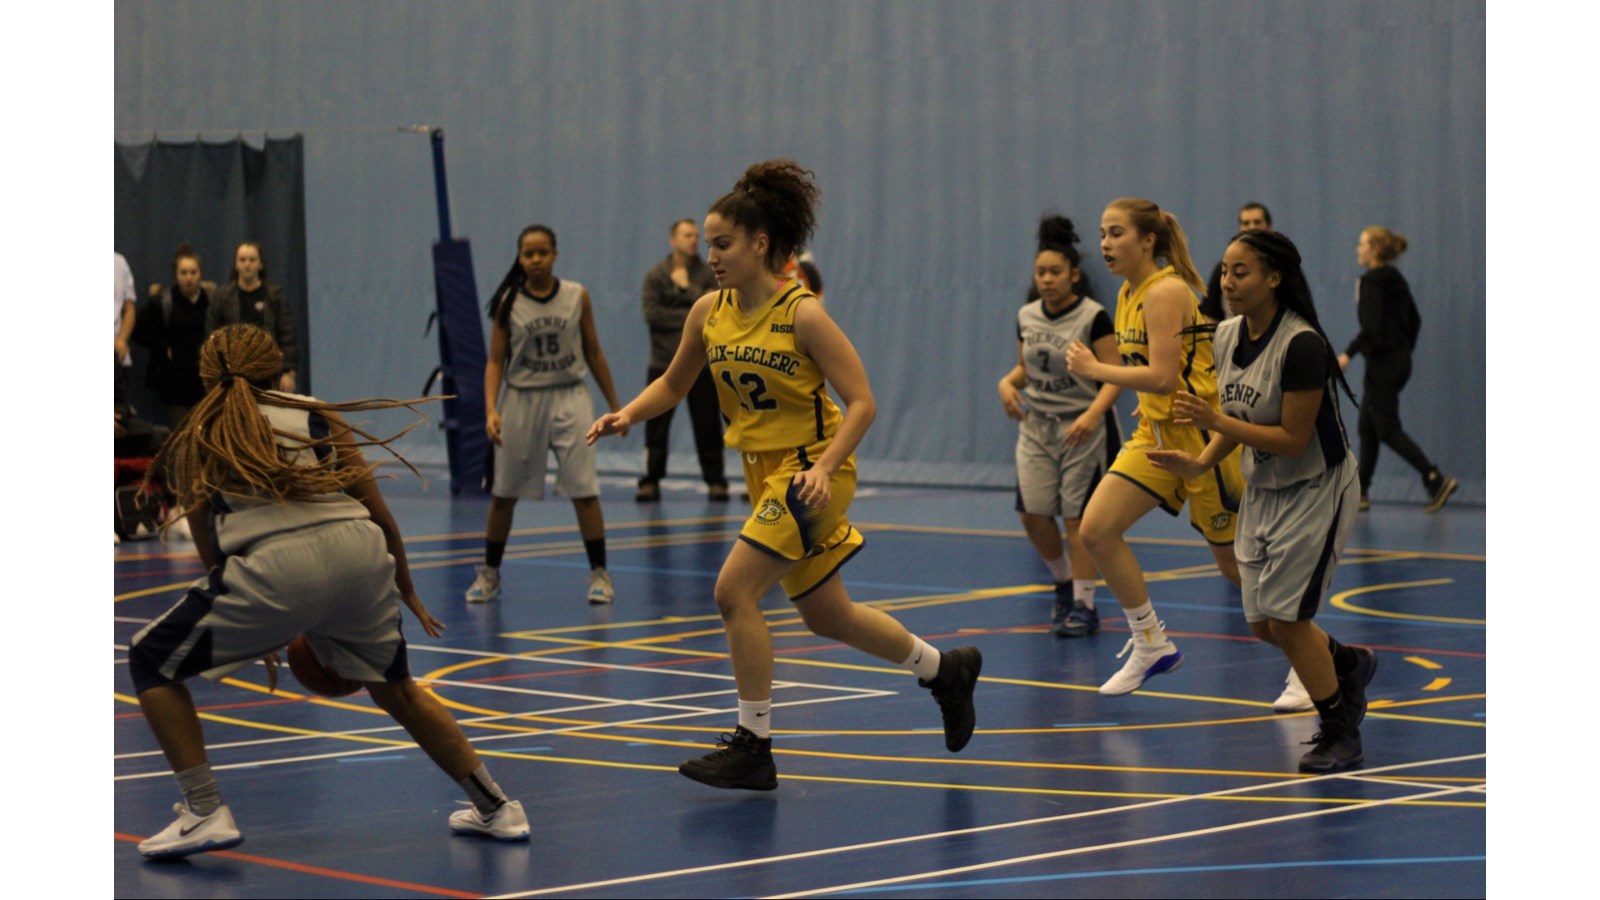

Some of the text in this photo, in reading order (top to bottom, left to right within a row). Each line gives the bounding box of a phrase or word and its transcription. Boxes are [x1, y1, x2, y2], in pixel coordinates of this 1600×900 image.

[524, 316, 567, 335] HENRI
[535, 334, 560, 357] 15
[1027, 329, 1068, 349] HENRI
[707, 344, 800, 376] LIX-LECLERC
[1037, 350, 1050, 373] 7
[721, 370, 777, 411] 12
